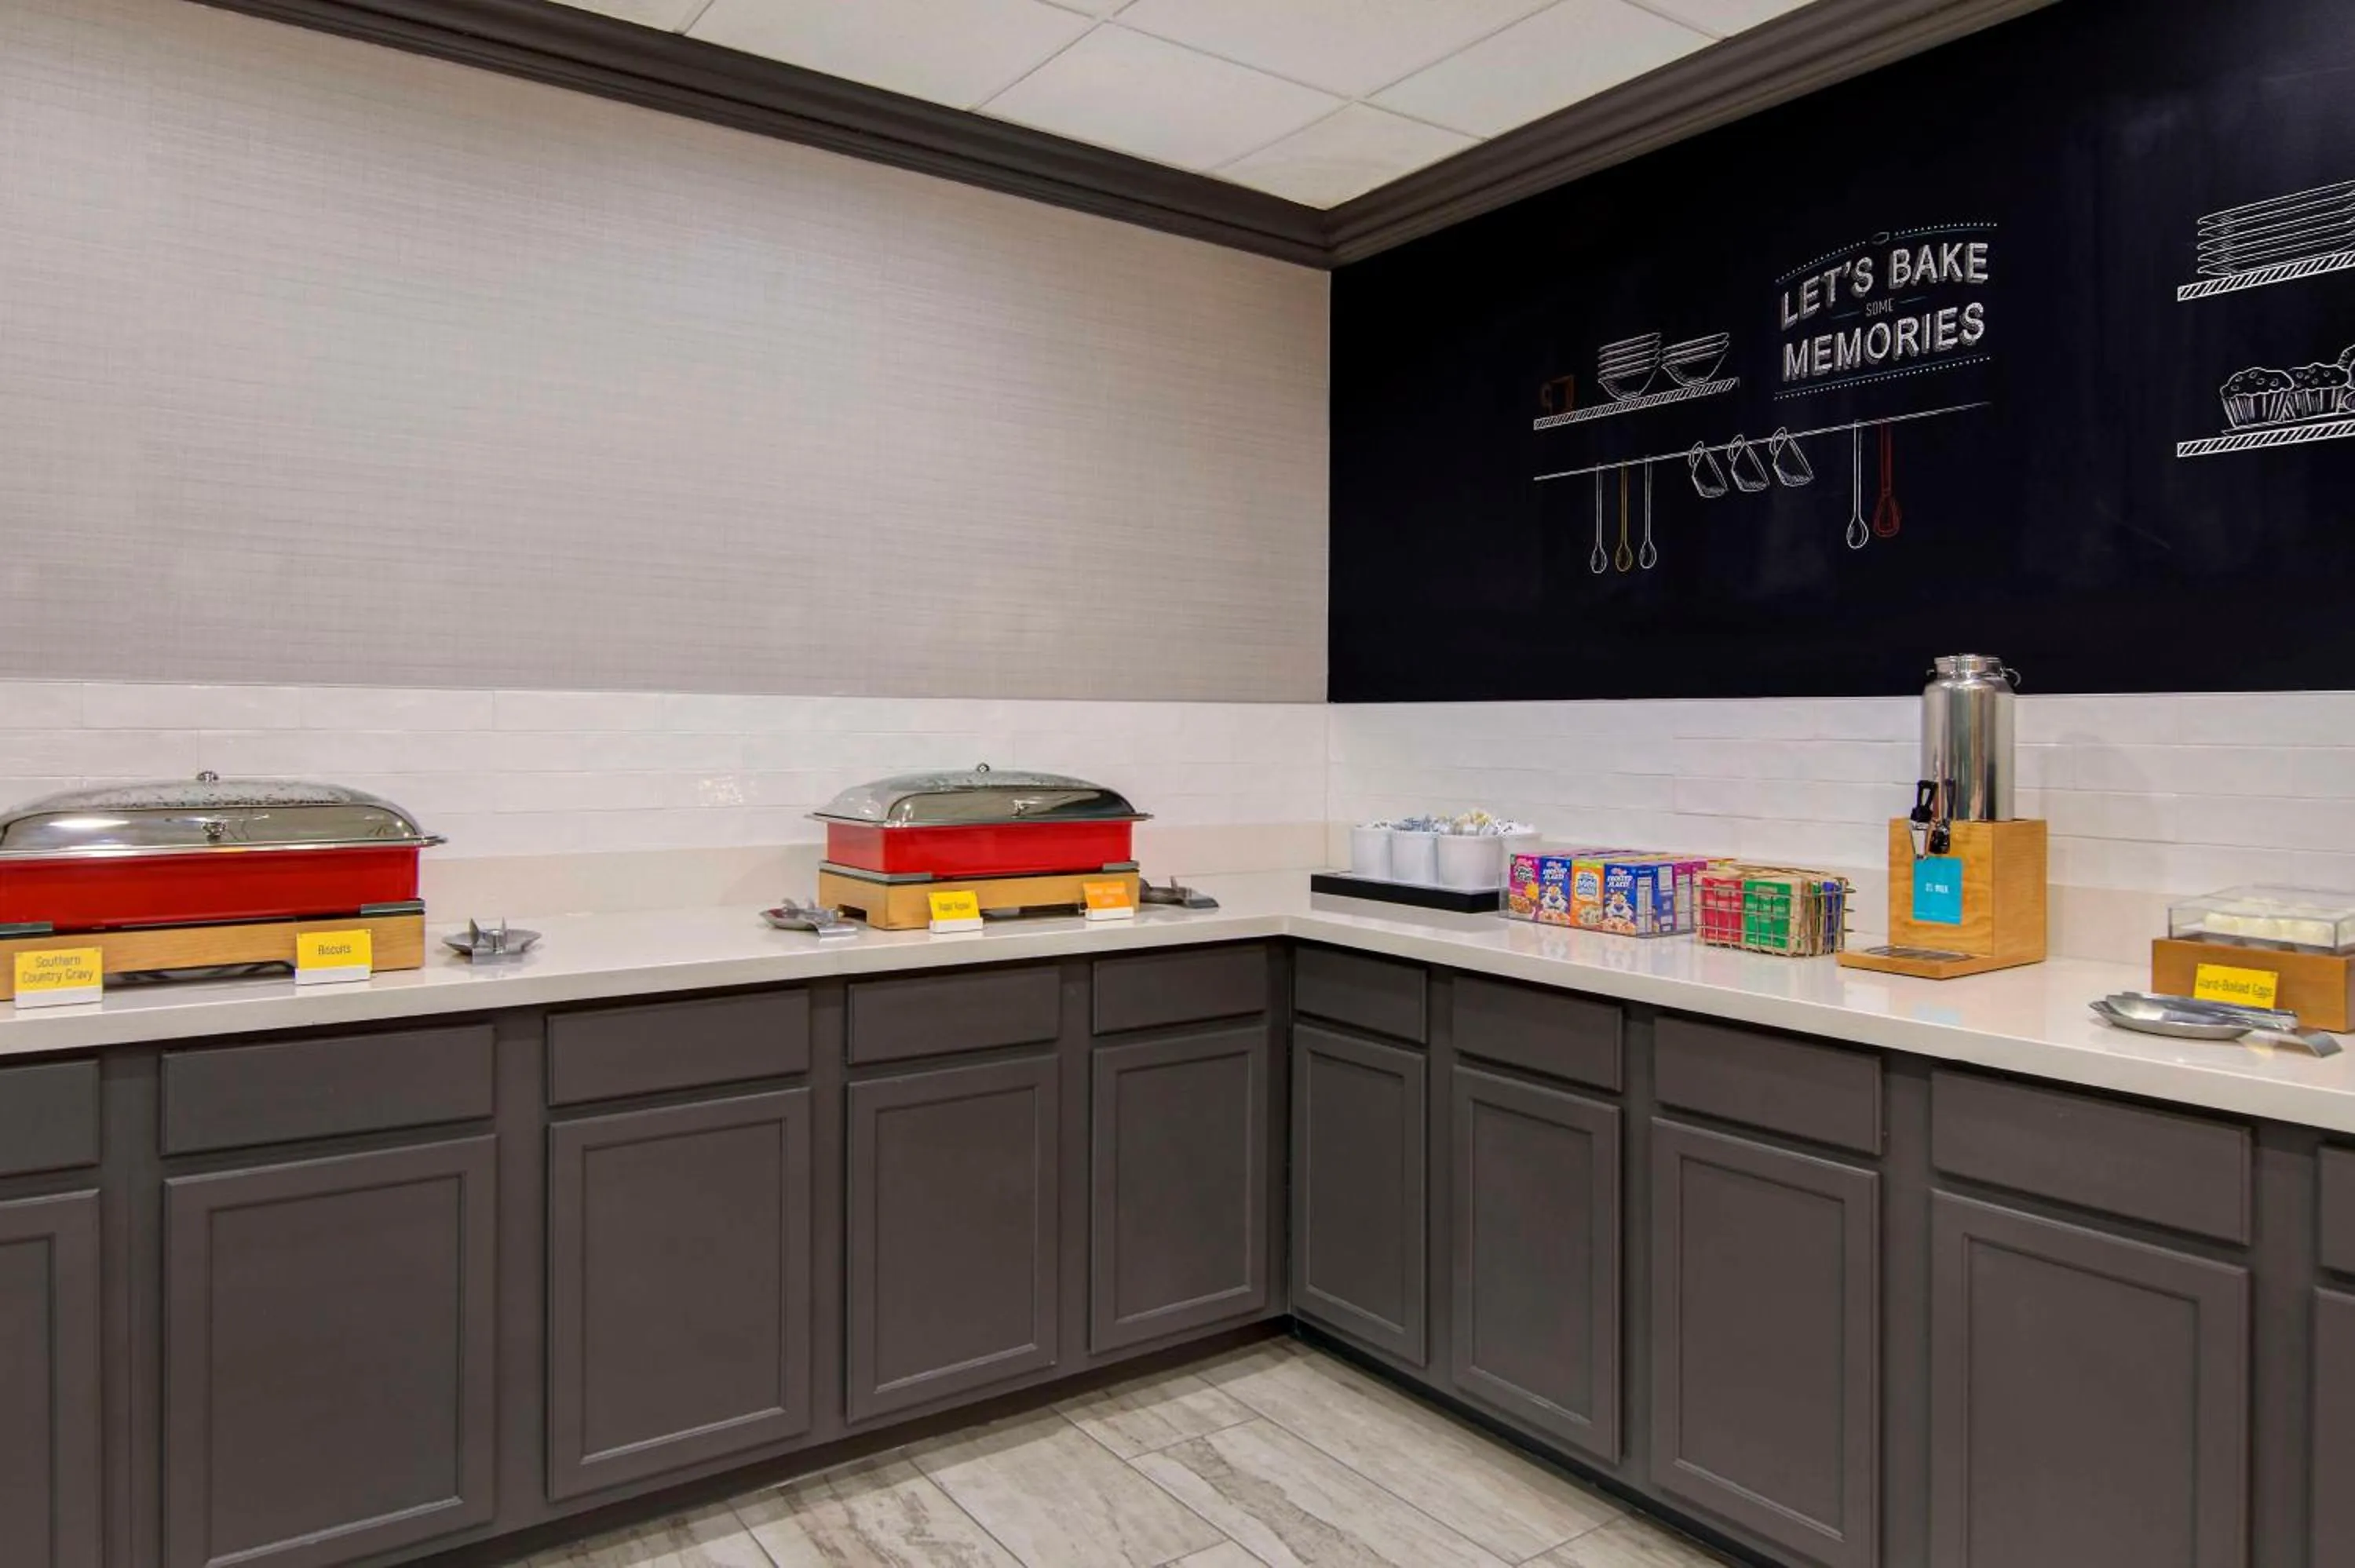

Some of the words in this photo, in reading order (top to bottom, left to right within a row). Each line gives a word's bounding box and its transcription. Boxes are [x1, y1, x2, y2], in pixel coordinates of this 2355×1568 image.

[1781, 256, 1875, 331] LET'S
[1889, 242, 1989, 290] BAKE
[1865, 297, 1895, 317] SOME
[1782, 301, 1985, 383] MEMORIES
[317, 943, 352, 955] Biscuits
[35, 954, 82, 968] Southern
[22, 971, 63, 986] Country
[65, 968, 93, 982] Gravy
